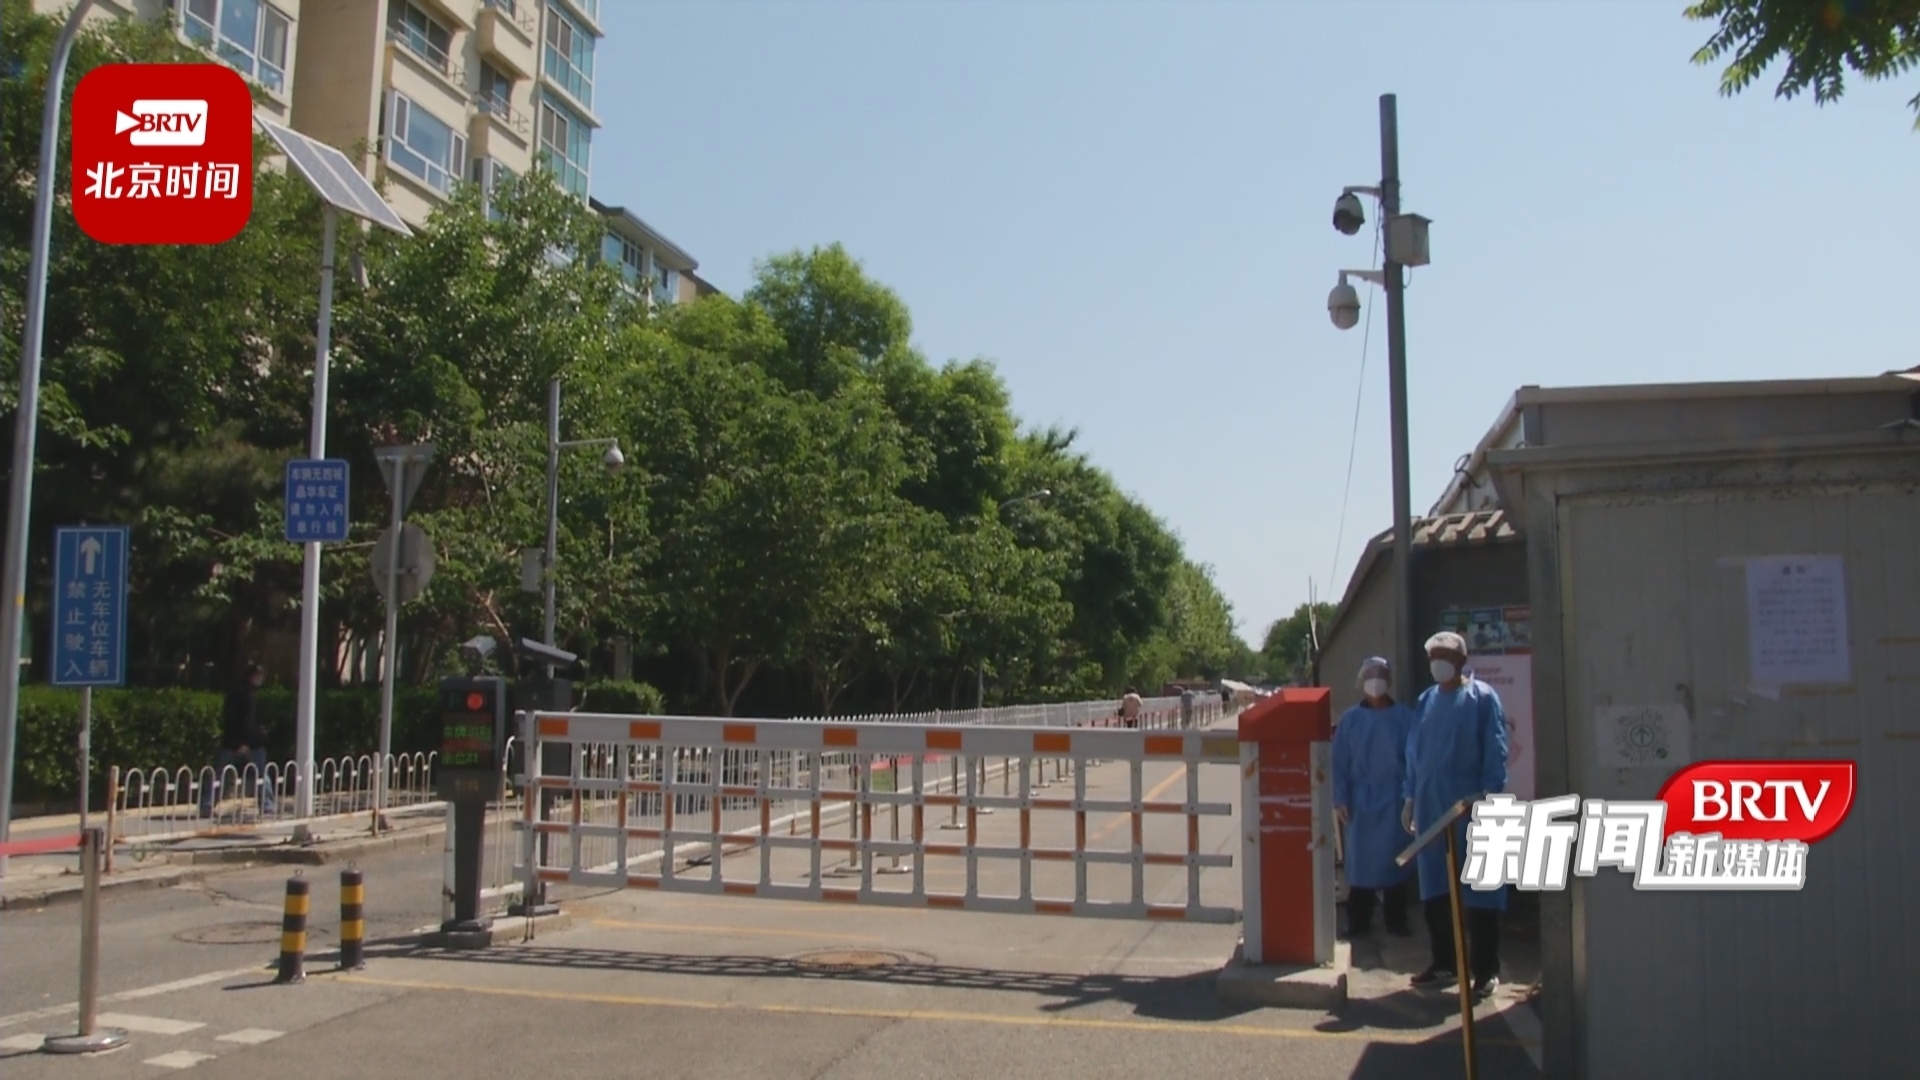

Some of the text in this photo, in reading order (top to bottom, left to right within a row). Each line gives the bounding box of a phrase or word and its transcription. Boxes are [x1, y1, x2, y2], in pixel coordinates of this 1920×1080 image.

[64, 581, 87, 677] 禁止驶入
[89, 581, 111, 677] 无车位车辆
